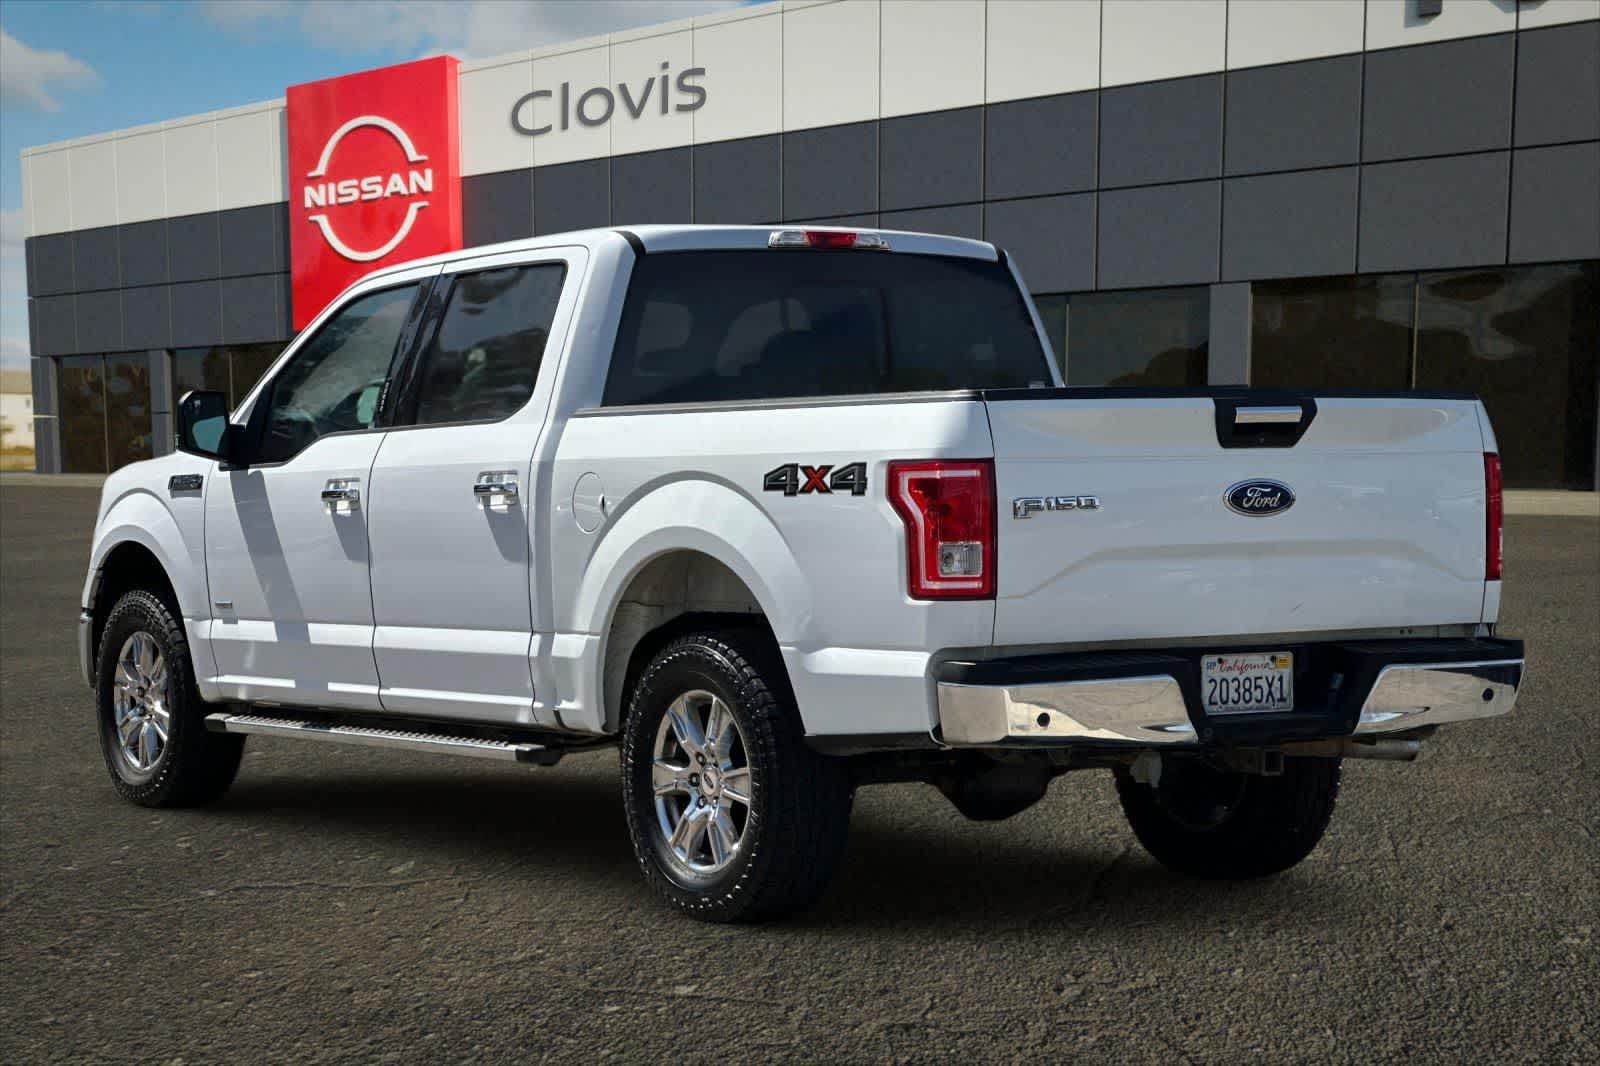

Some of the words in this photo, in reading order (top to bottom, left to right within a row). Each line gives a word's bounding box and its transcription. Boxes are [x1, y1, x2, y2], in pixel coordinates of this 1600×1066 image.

[511, 62, 707, 136] Clovis
[303, 168, 433, 209] NISSAN
[1242, 486, 1281, 508] Ford
[1218, 658, 1274, 676] California
[1208, 674, 1287, 706] 20385X1
